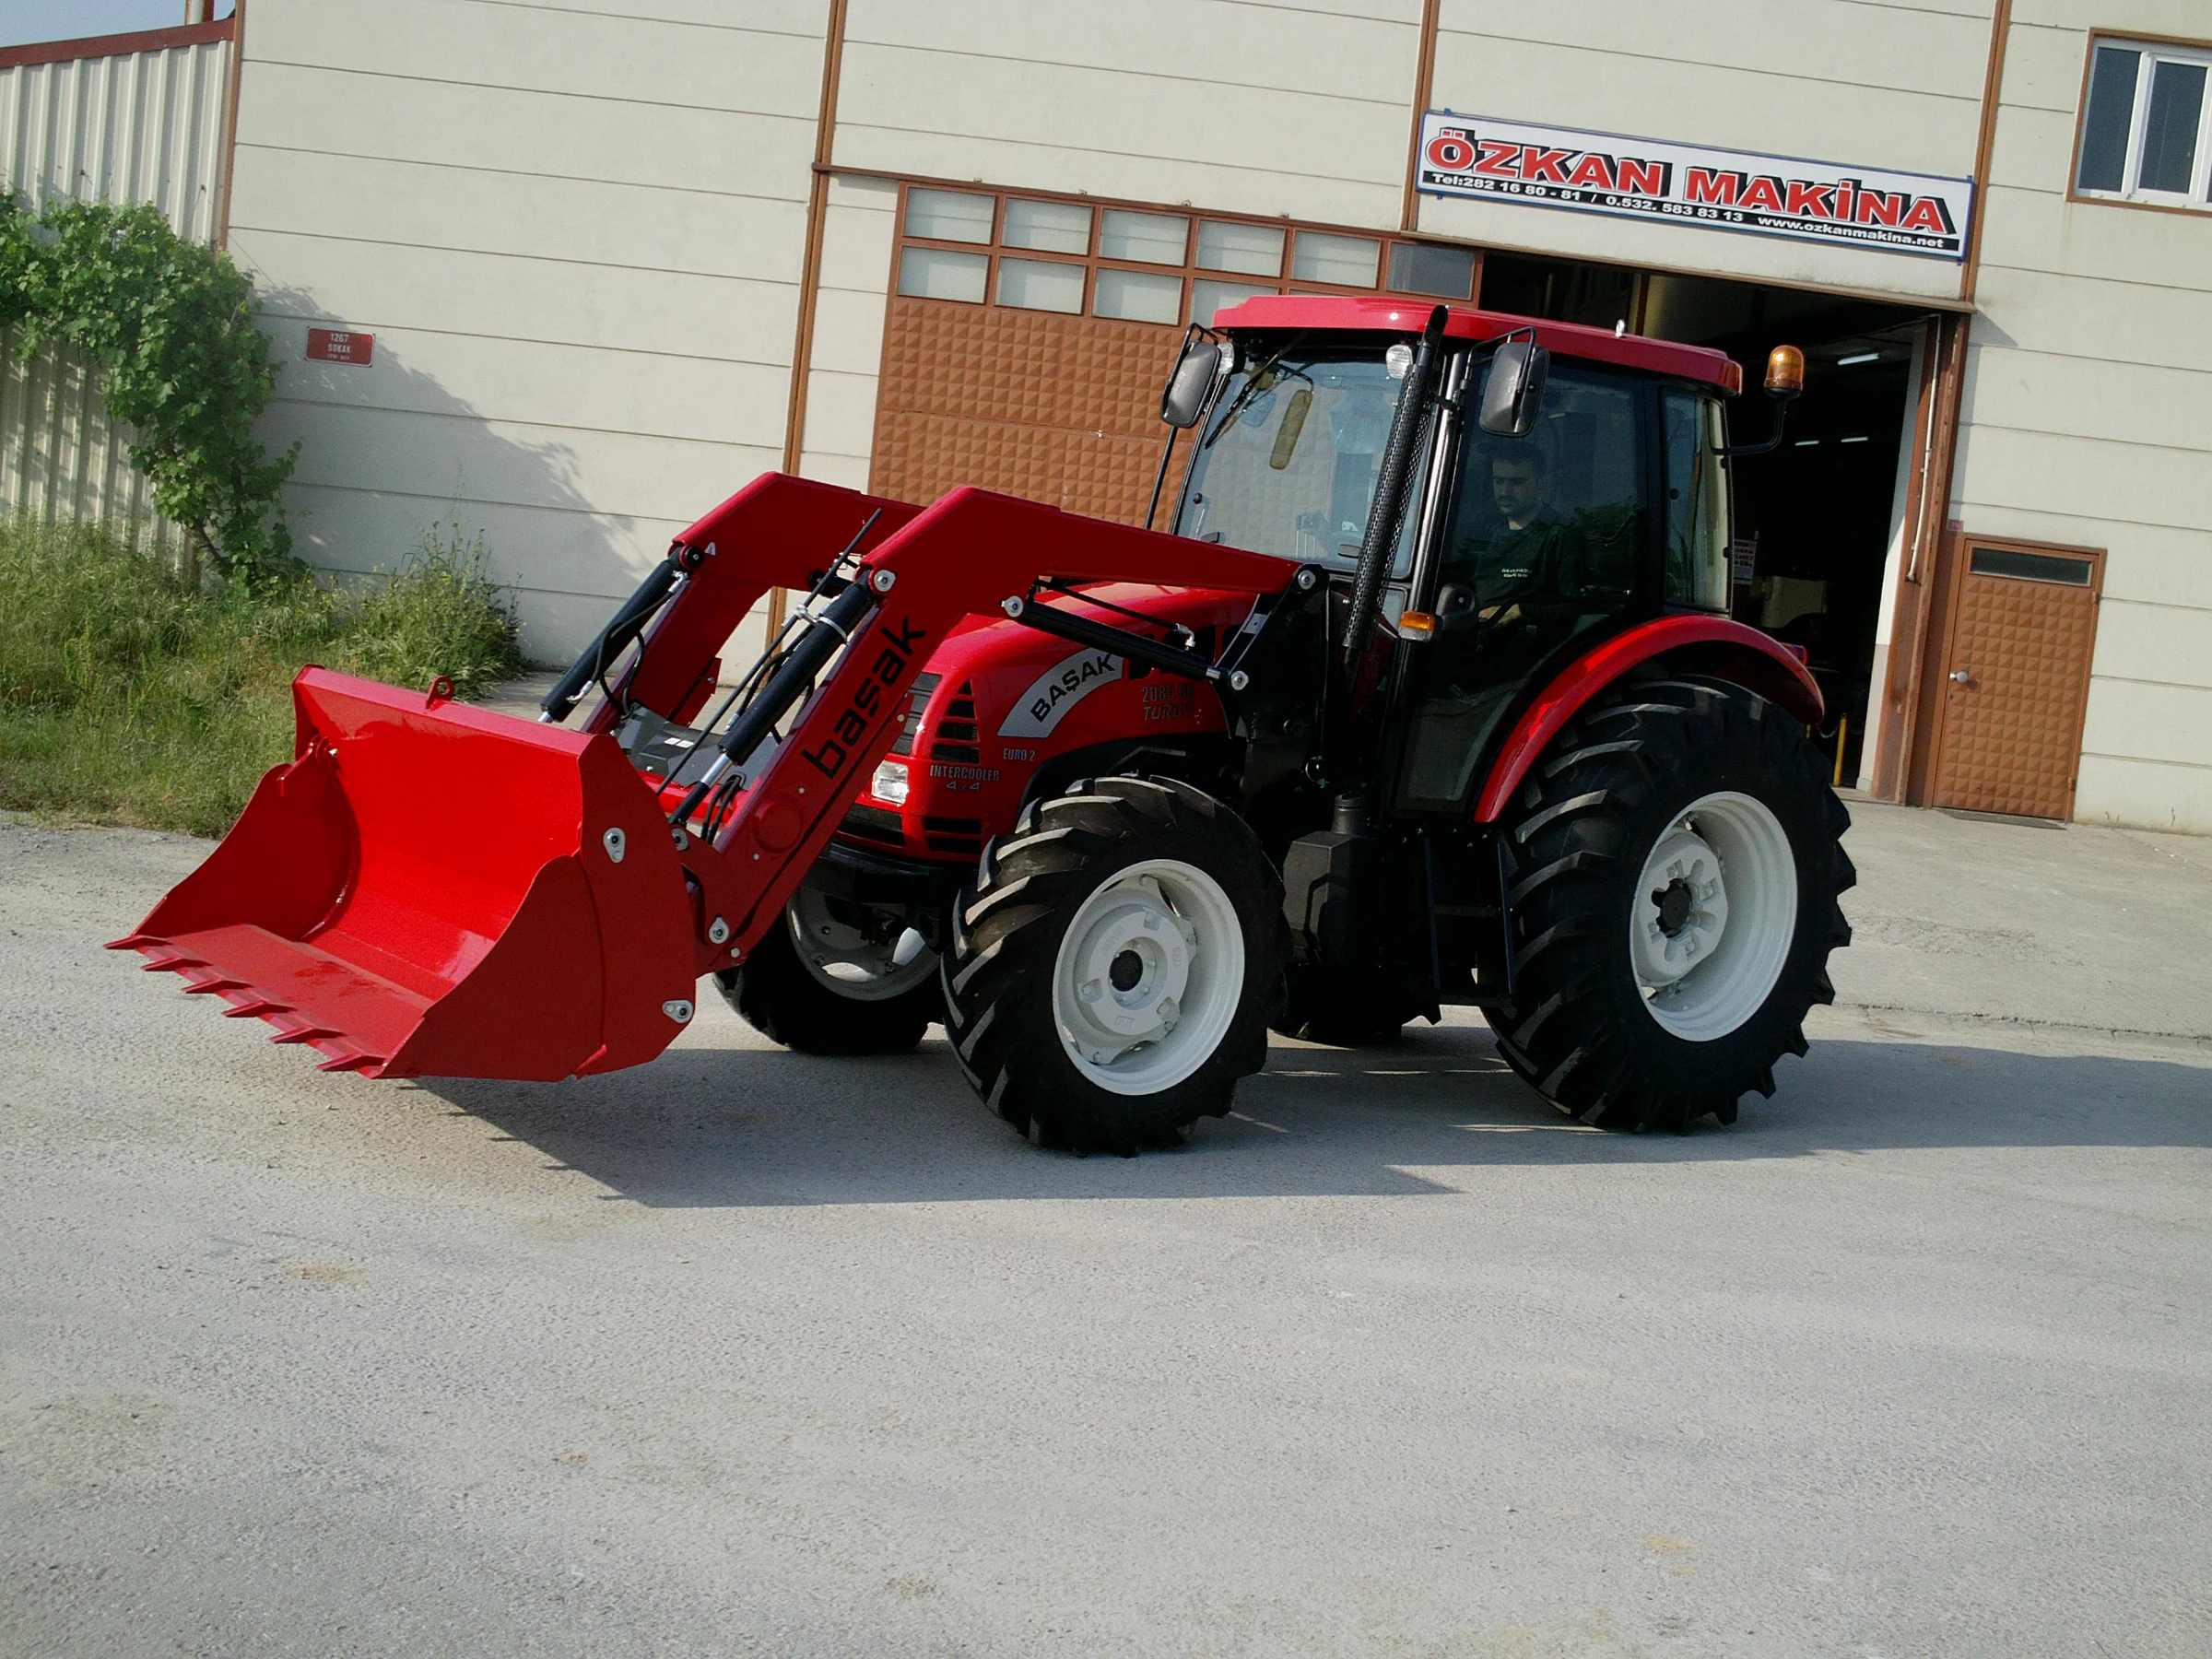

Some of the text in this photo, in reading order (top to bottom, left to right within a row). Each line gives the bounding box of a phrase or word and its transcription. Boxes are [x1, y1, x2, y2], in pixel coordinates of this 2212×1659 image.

[1425, 127, 1674, 197] ÖZKAN
[1431, 172, 1495, 190] Tel:282
[1500, 182, 1521, 194] 16
[1524, 183, 1547, 196] 80
[1560, 188, 1582, 202] 81
[1662, 203, 1693, 216] 583
[1697, 208, 1718, 219] 83
[1723, 211, 1744, 222] 13
[1757, 216, 1945, 249] www.ozkanmakina.net
[329, 333, 349, 343] 1267
[326, 343, 351, 354] SOKAK
[1030, 653, 1115, 723] BAŞAK
[1141, 684, 1175, 703] 2085
[1144, 700, 1195, 722] TURBO
[1002, 747, 1036, 762] EURO 2
[929, 764, 1000, 782] INTERCOOLER
